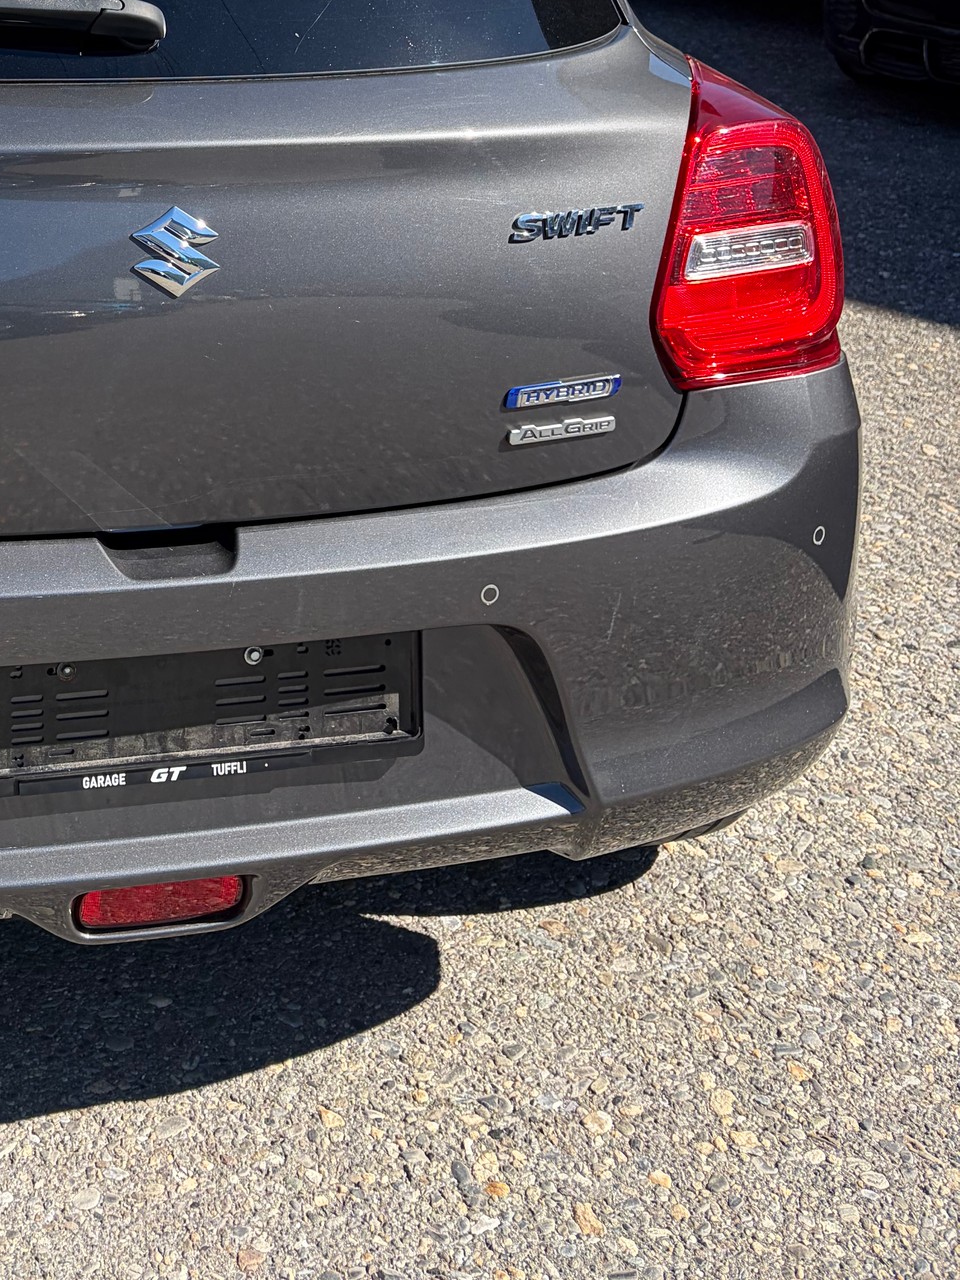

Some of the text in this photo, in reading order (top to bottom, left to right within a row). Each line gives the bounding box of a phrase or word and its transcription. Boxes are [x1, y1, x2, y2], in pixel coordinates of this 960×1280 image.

[508, 203, 645, 243] SWIFT
[525, 382, 608, 404] HYBRID
[82, 761, 247, 789] GARAGE GT TUFFLI
